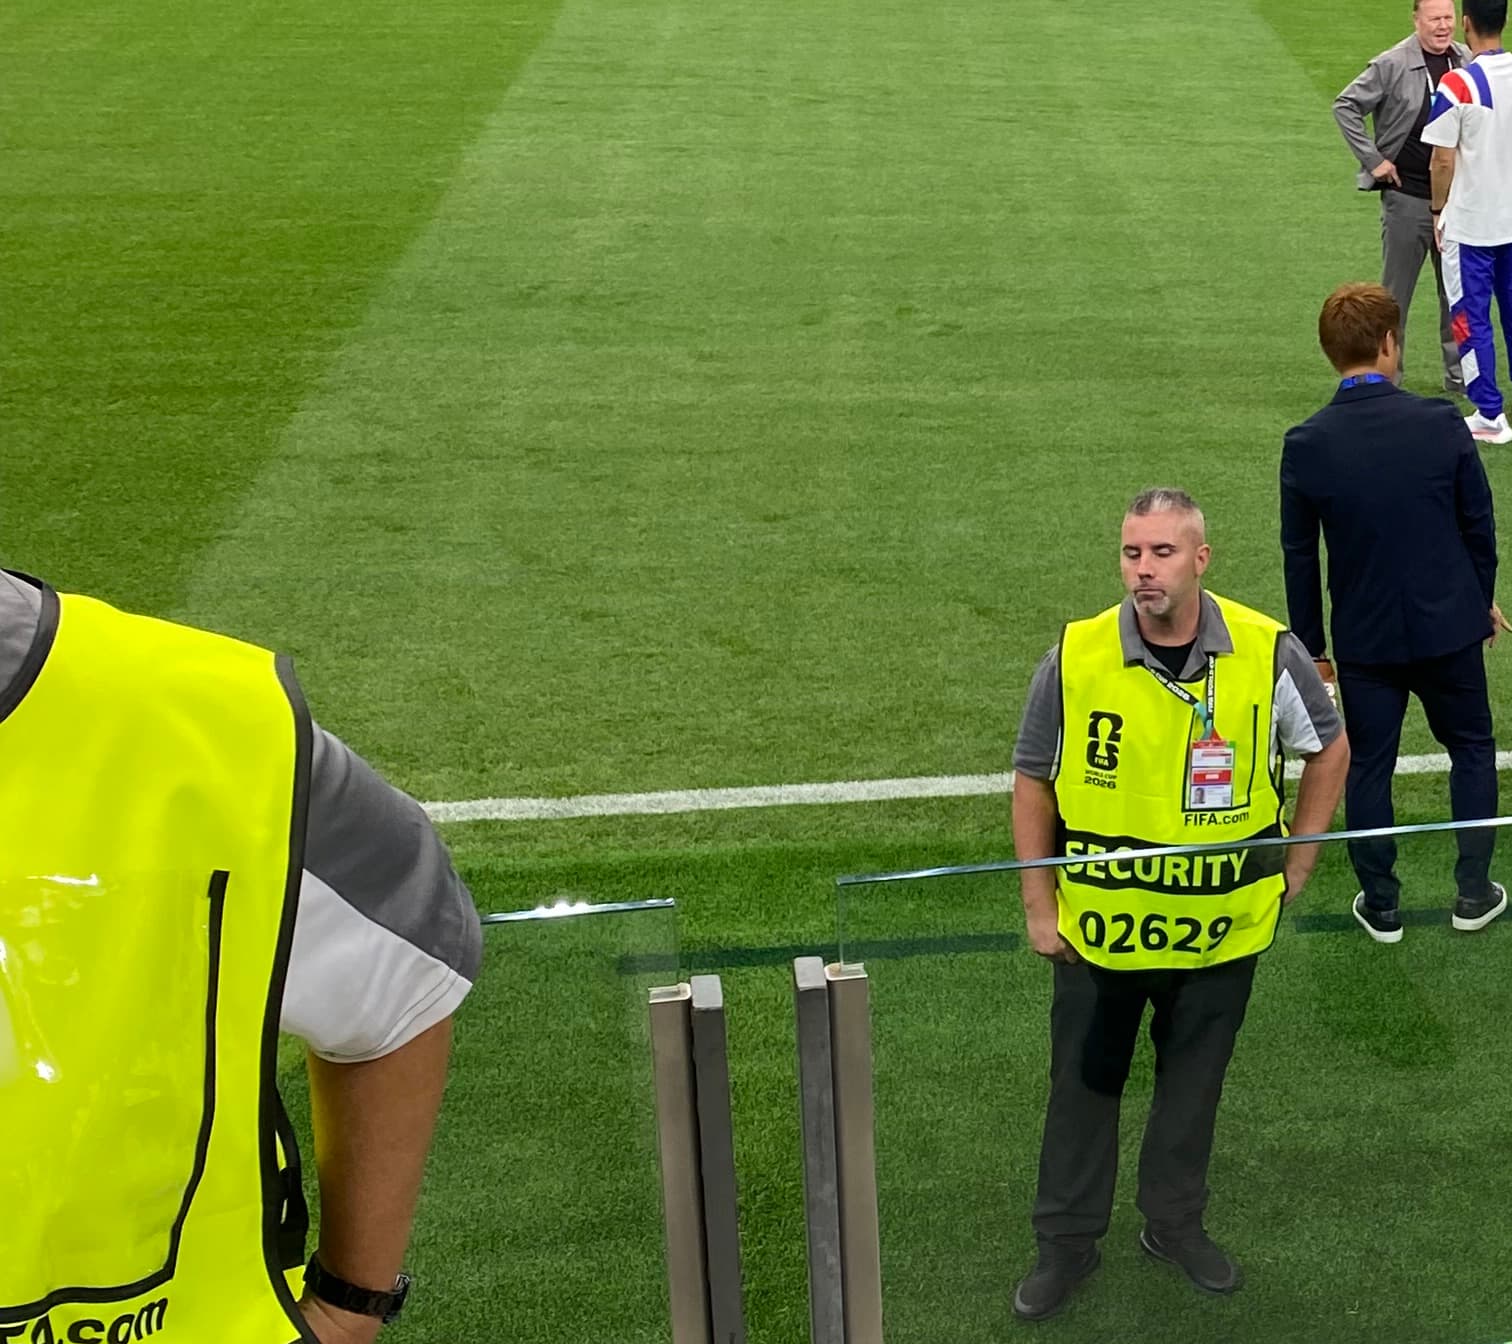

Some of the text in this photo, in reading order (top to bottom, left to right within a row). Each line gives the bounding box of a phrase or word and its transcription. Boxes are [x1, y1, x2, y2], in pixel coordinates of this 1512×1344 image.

[1084, 776, 1117, 790] 2026
[1184, 812, 1250, 827] FIFA.com
[1078, 910, 1234, 954] 02629
